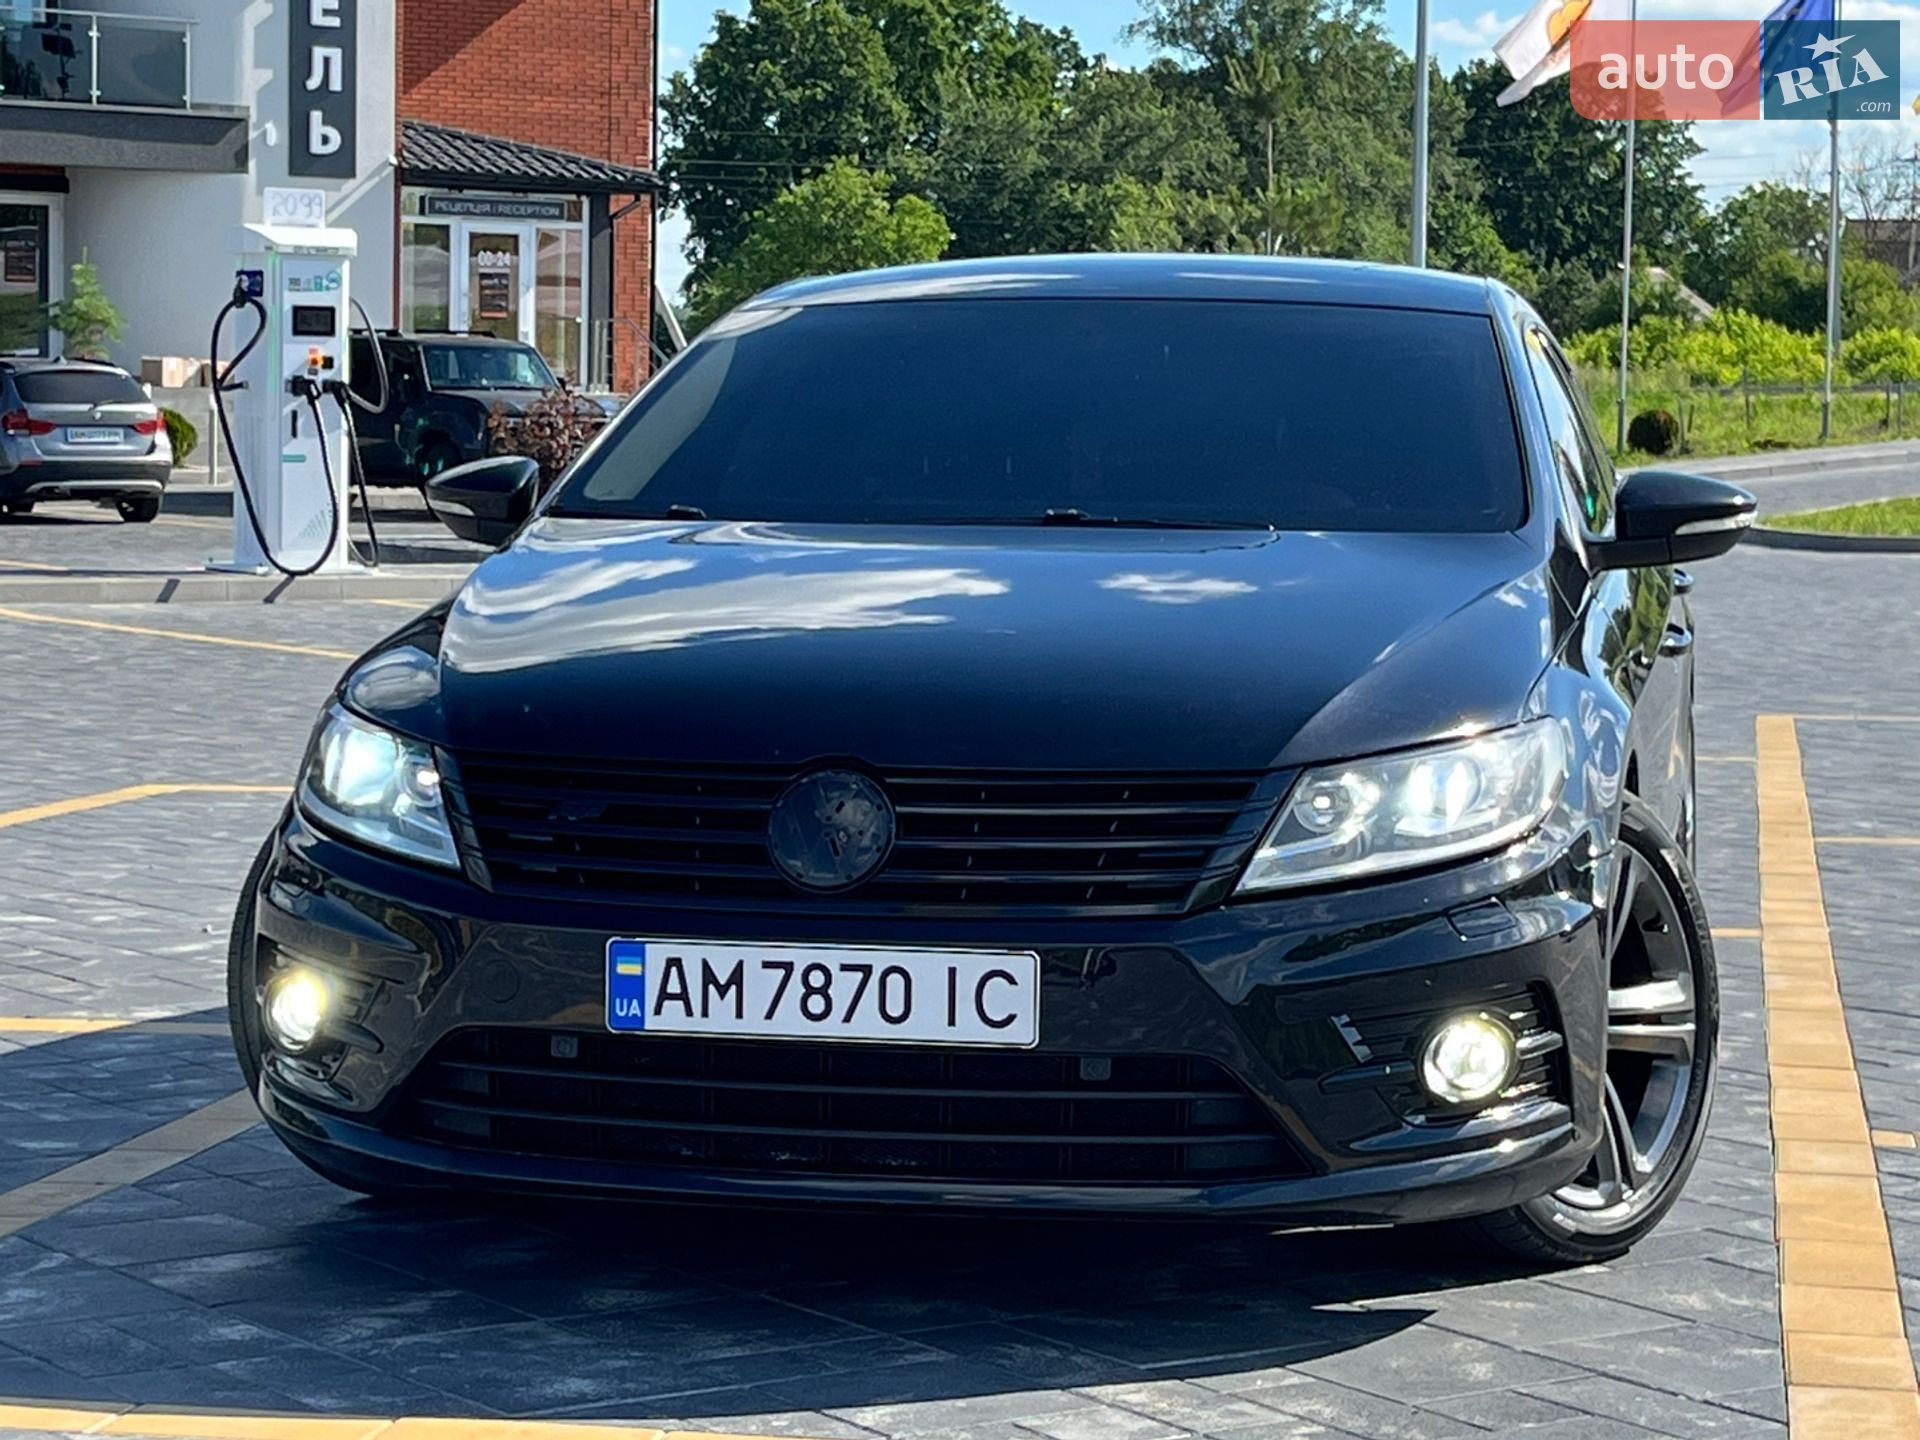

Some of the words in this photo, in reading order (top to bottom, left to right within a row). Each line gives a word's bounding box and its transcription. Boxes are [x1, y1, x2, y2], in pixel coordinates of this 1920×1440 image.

[498, 204, 560, 216] RECEPTION
[653, 957, 744, 1019] AM
[762, 961, 913, 1024] 7870
[947, 966, 1019, 1029] IC
[615, 997, 641, 1017] UA
